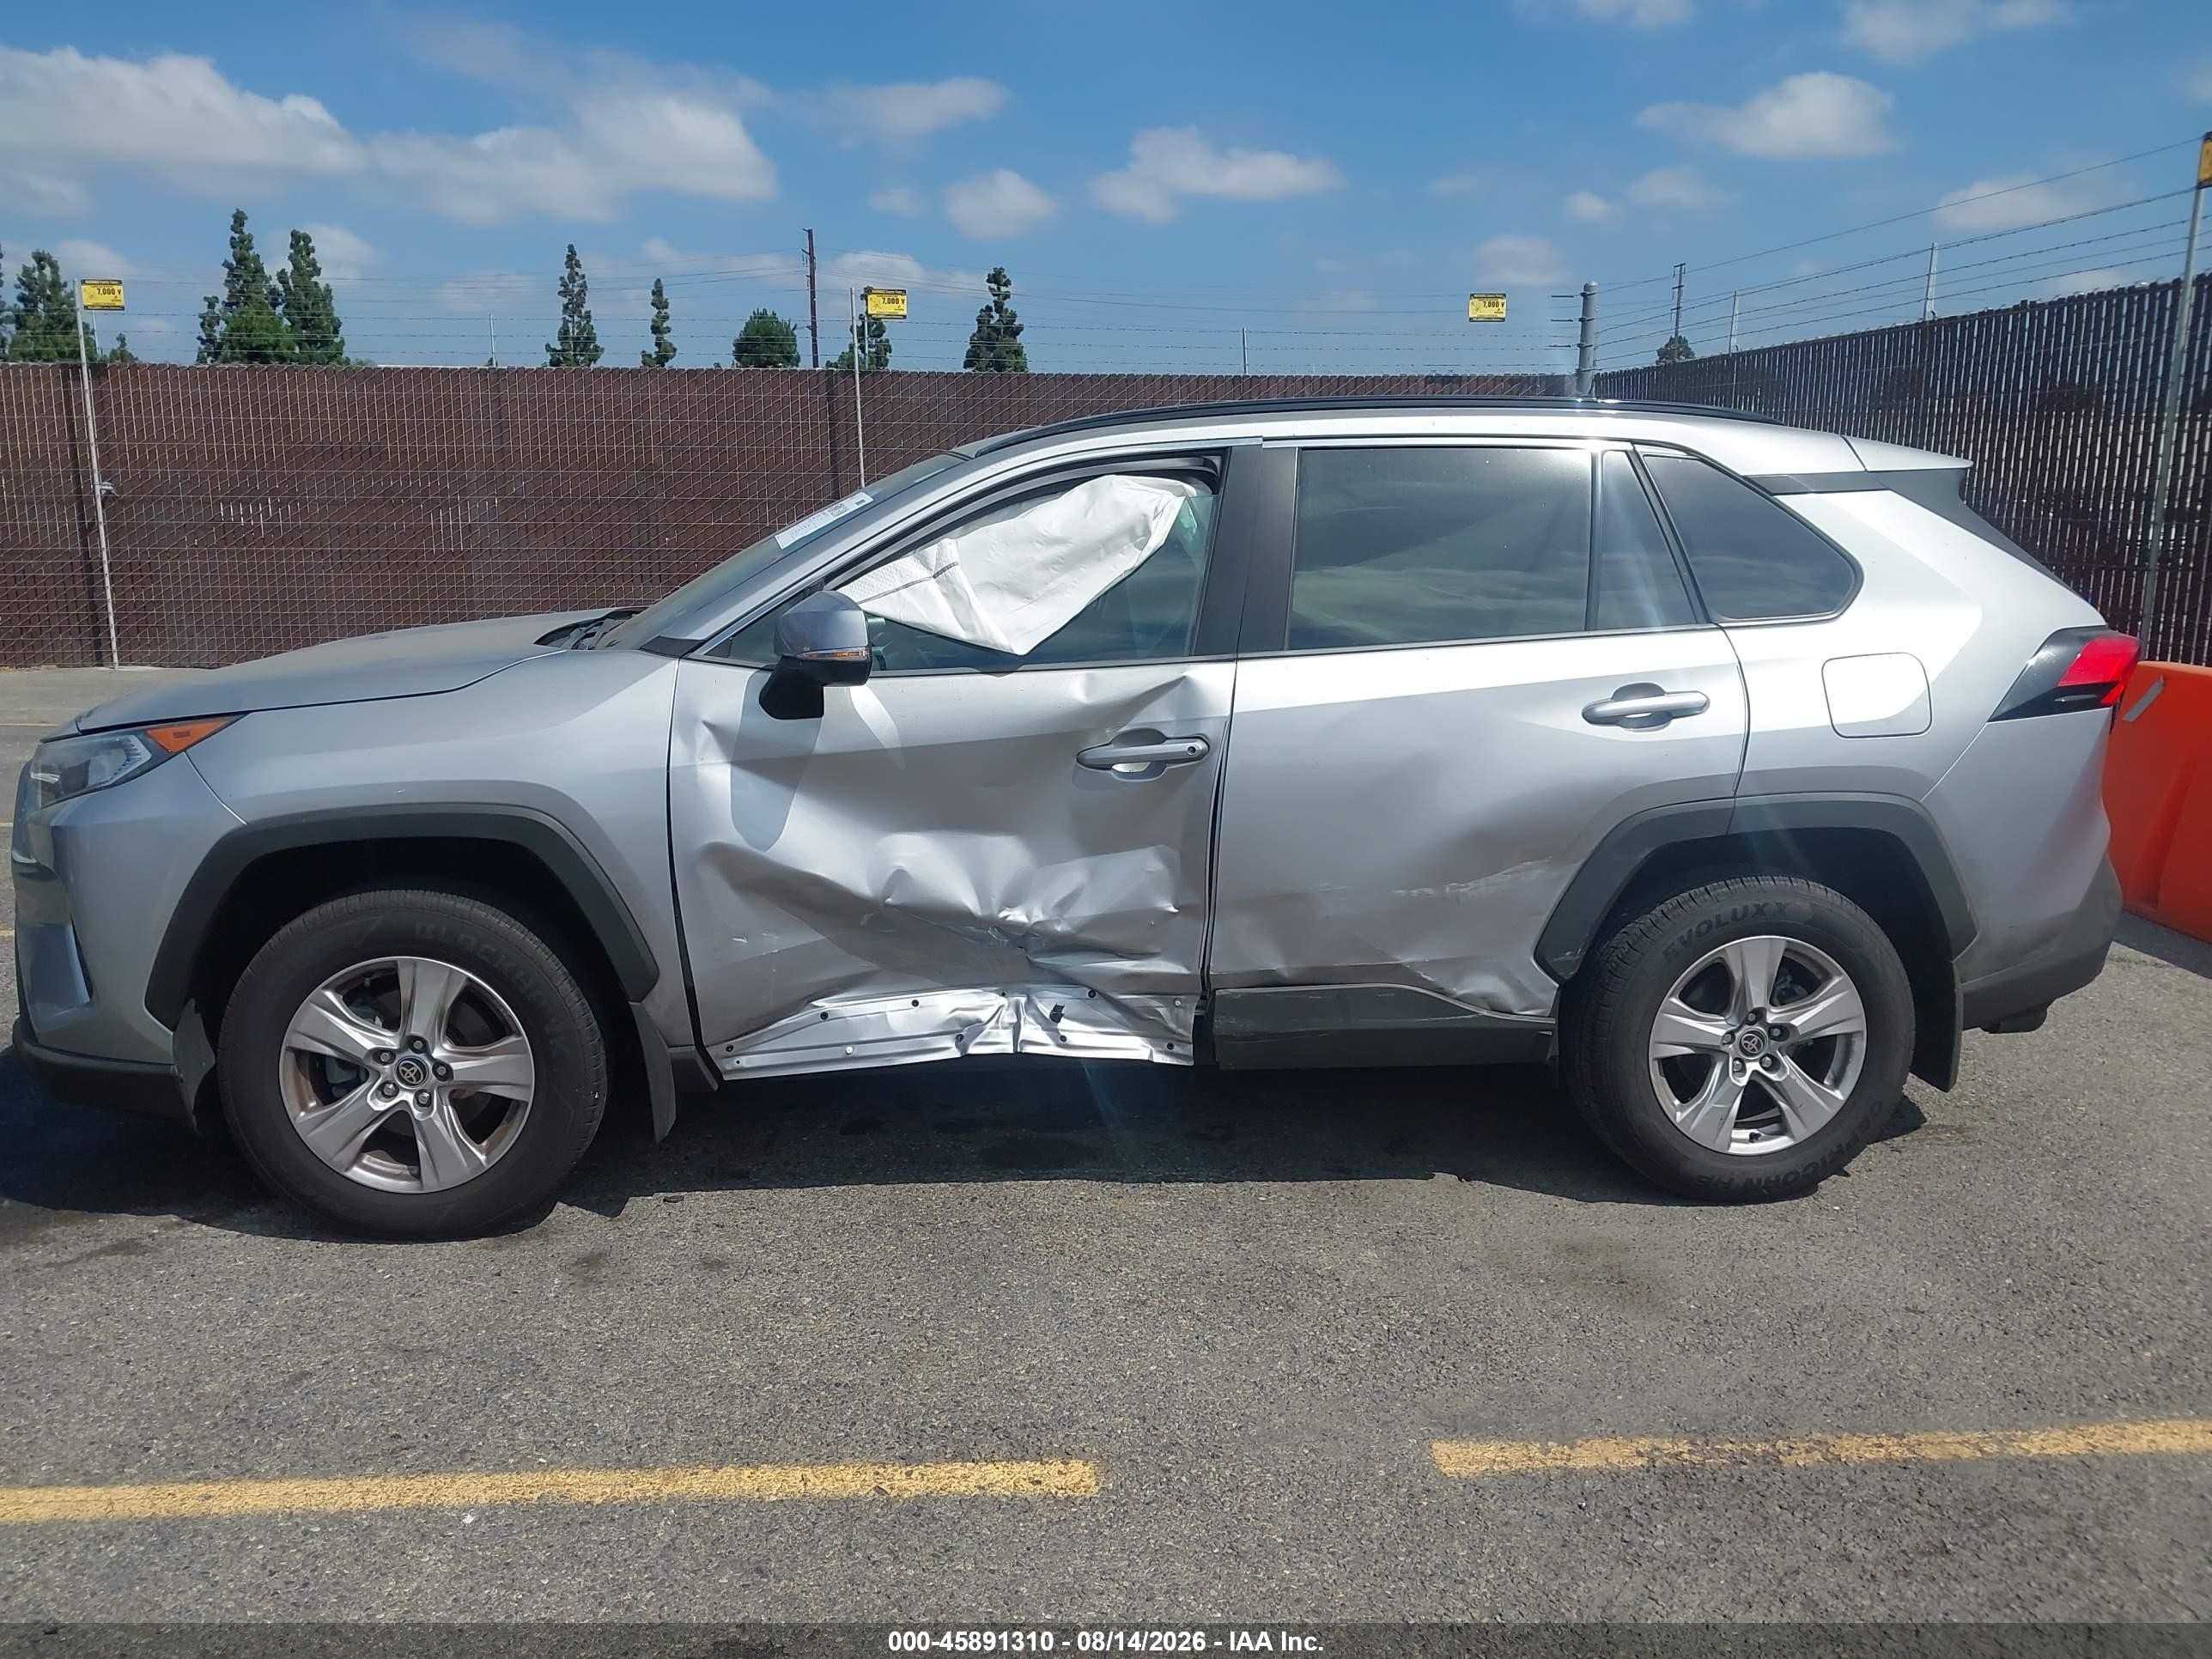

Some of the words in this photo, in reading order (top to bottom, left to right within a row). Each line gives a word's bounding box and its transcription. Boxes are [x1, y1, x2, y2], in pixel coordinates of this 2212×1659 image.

[96, 288, 116, 296] 7,000
[882, 297, 900, 306] 7,000
[1482, 301, 1499, 309] 7,000
[1662, 902, 1791, 959] EVOLUXX
